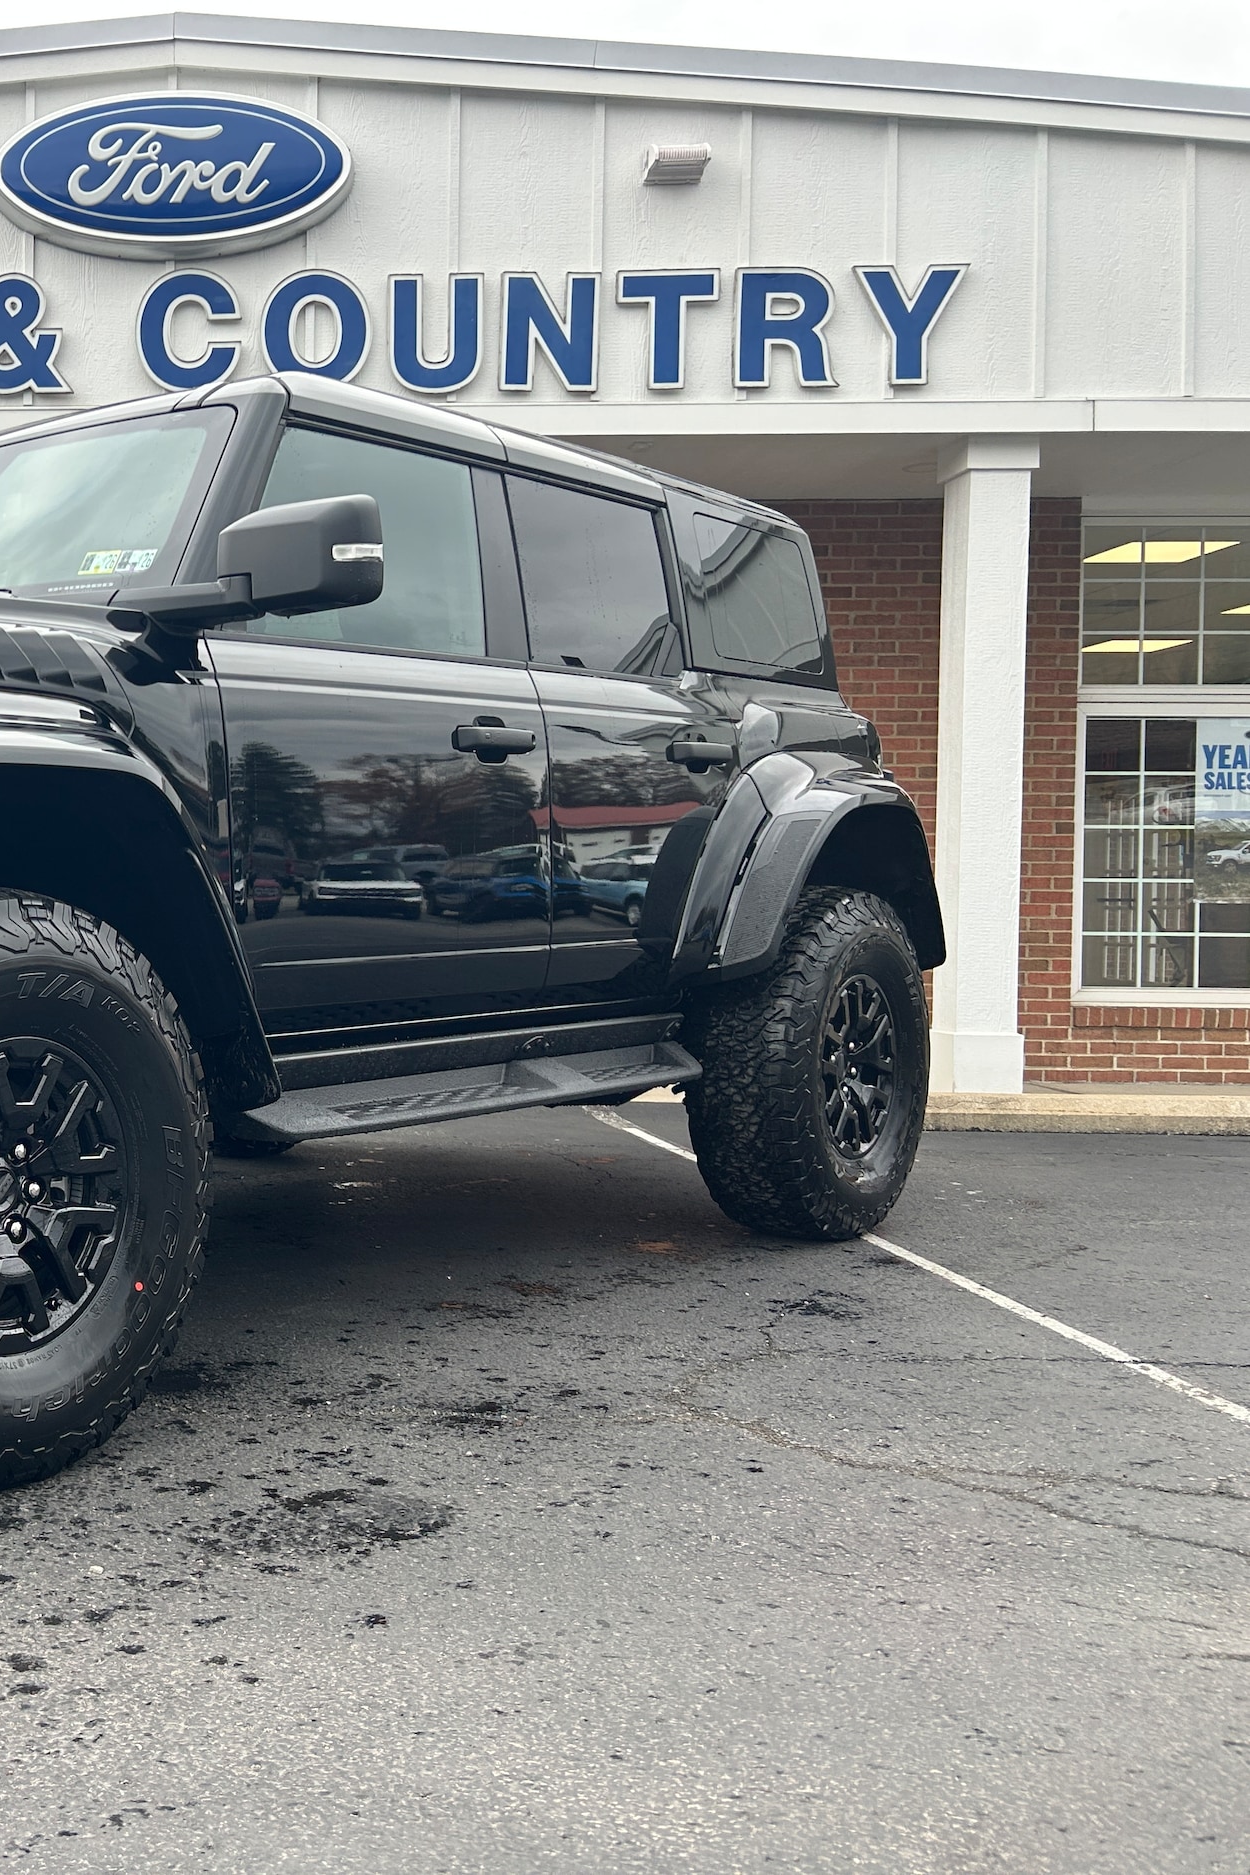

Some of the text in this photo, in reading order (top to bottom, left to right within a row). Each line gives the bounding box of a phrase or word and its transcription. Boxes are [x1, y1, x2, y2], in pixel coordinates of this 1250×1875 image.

[67, 121, 277, 207] Ford
[135, 263, 971, 395] COUNTRY
[1202, 744, 1250, 769] YEA
[16, 971, 96, 1009] T/A
